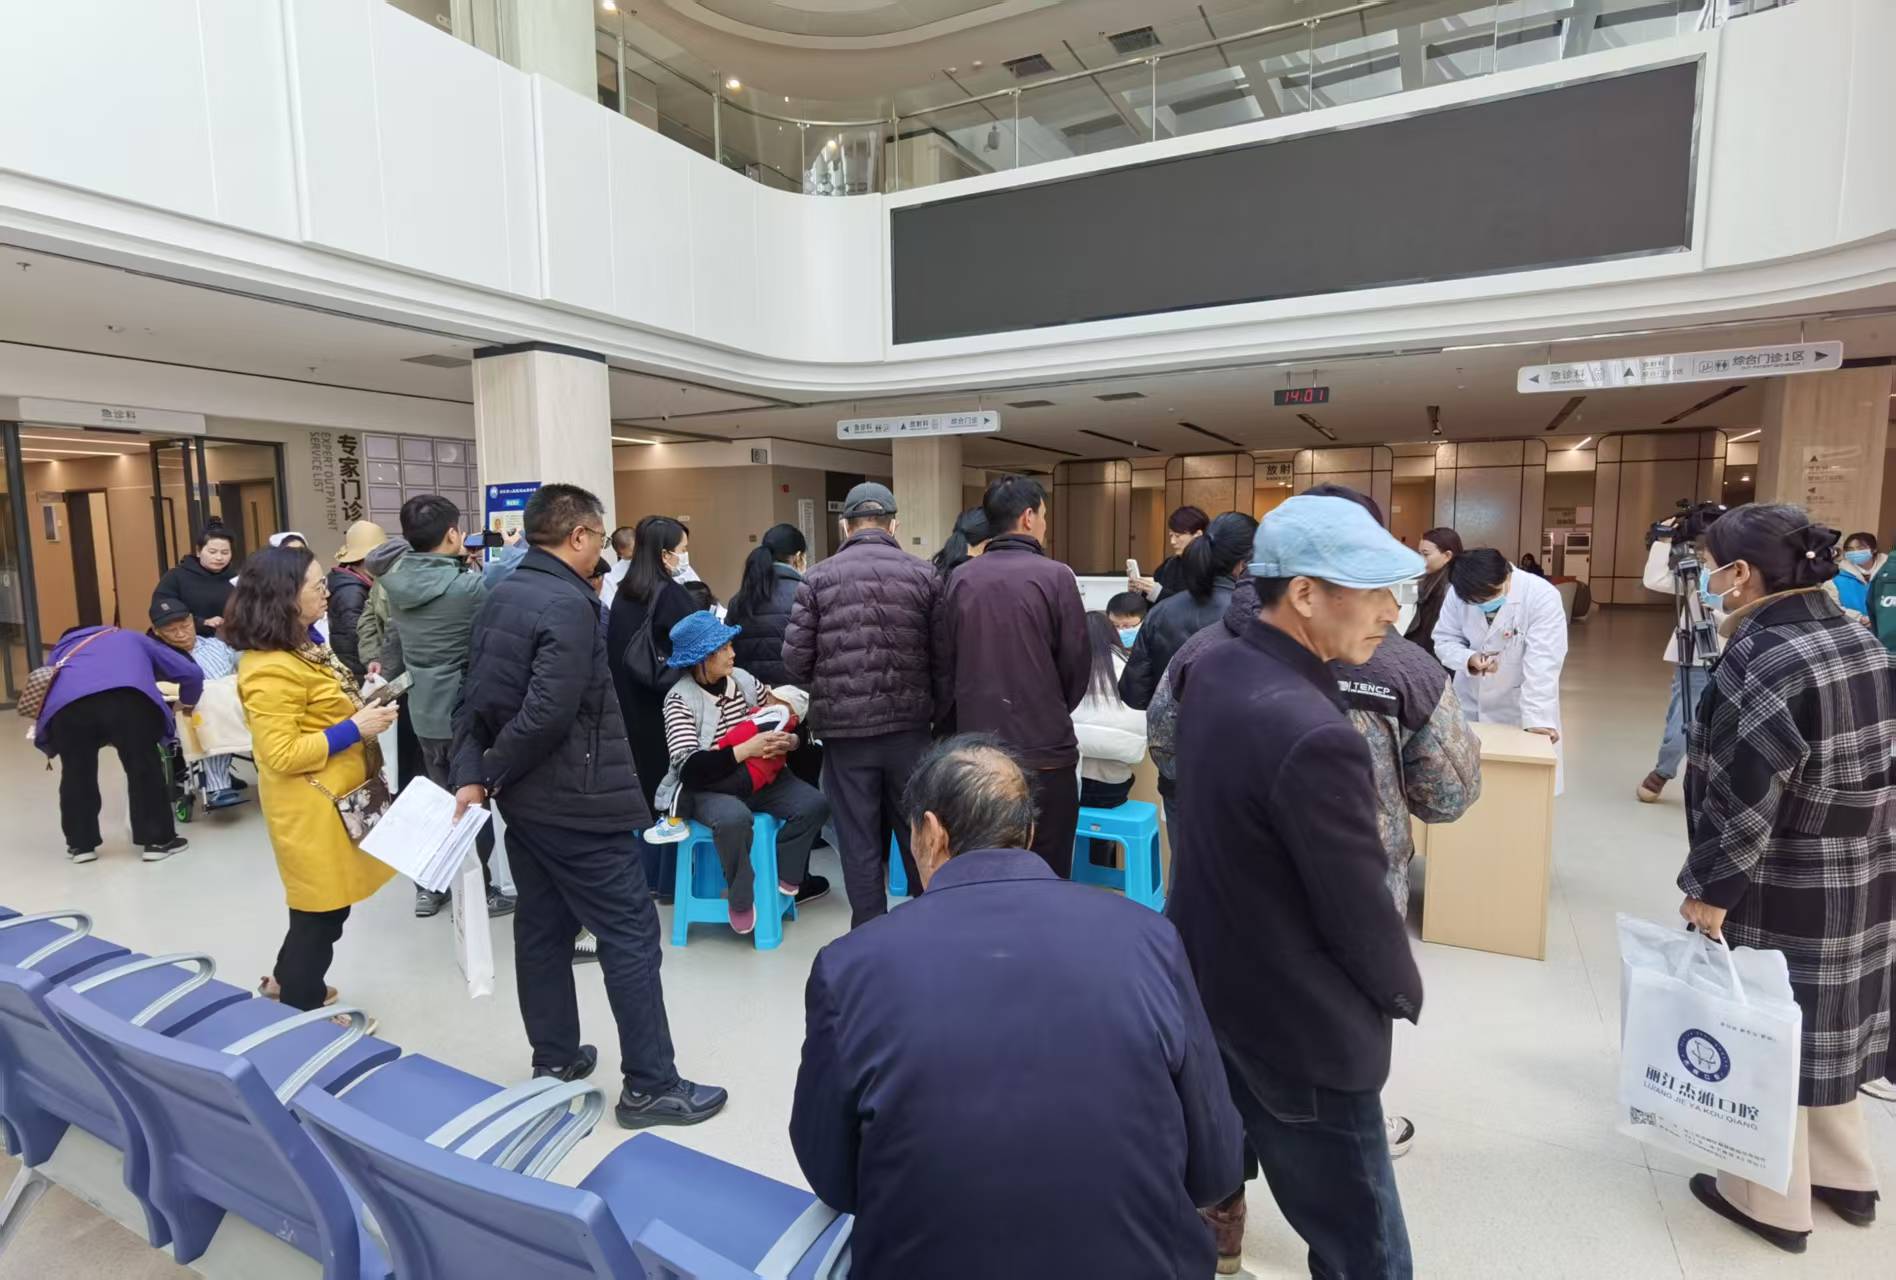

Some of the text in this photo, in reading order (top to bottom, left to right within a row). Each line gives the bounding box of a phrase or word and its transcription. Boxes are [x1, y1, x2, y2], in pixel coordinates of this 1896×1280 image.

[310, 431, 324, 494] SERVICE LIST
[320, 432, 338, 532] EXPERT OUTPATIENT
[337, 434, 363, 534] 专家门诊
[1703, 1108, 1724, 1120] KOU
